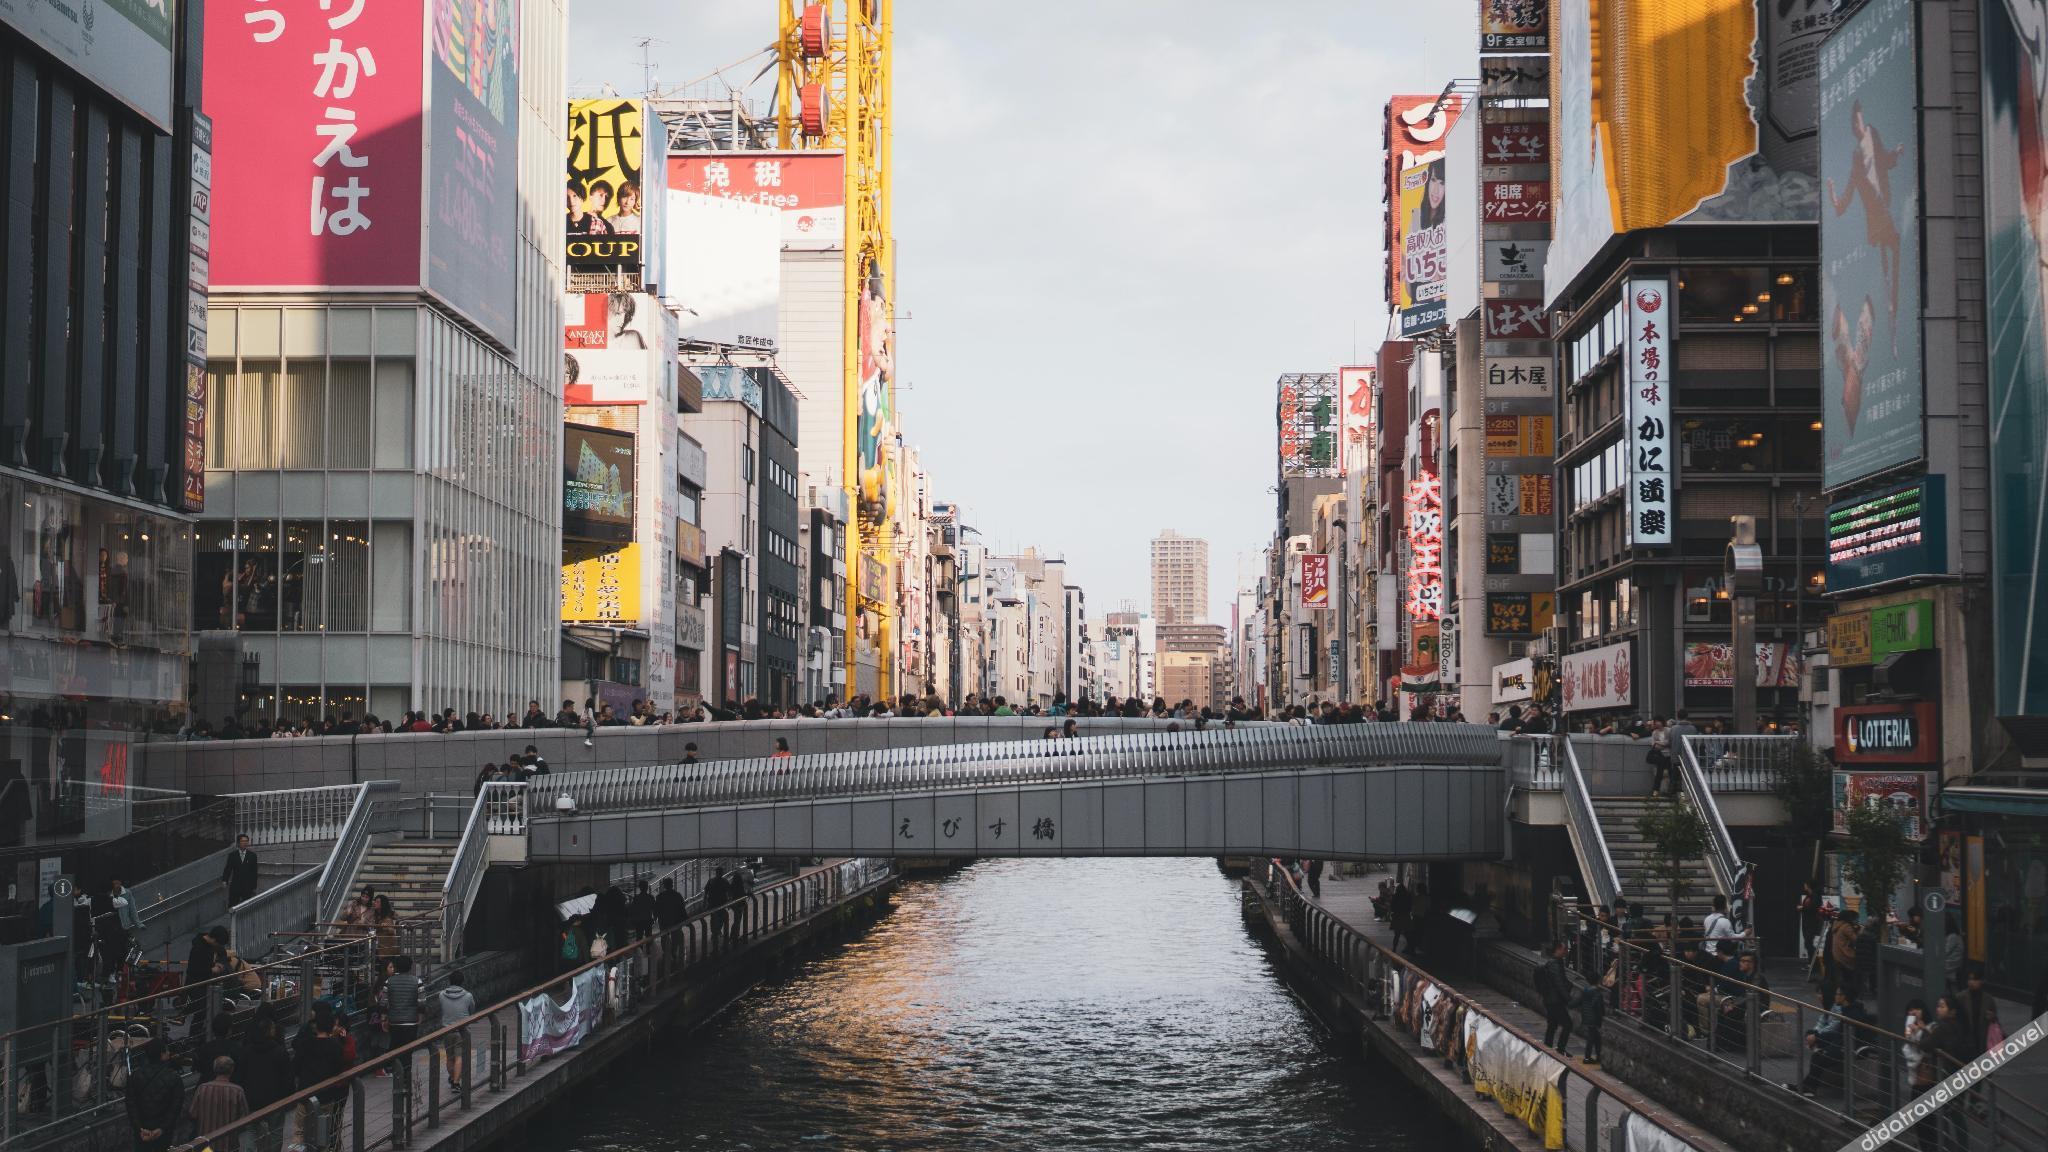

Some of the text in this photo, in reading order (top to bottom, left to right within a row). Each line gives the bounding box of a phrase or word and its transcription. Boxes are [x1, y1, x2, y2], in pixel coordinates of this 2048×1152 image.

[703, 161, 782, 187] 免税
[759, 191, 799, 207] Free
[1494, 184, 1523, 200] 相席
[1486, 201, 1549, 218] ダイニング
[1489, 363, 1547, 385] 白木屋
[1638, 320, 1661, 406] 本場の味
[1638, 415, 1665, 535] かに道楽
[1404, 470, 1443, 621] 大阪王将
[1303, 562, 1314, 595] ドラッグ
[1314, 556, 1326, 588] ツルハ
[1491, 617, 1529, 631] ドンキー
[1859, 718, 1912, 748] LOTTERIA
[898, 817, 1055, 840] えびす橋
